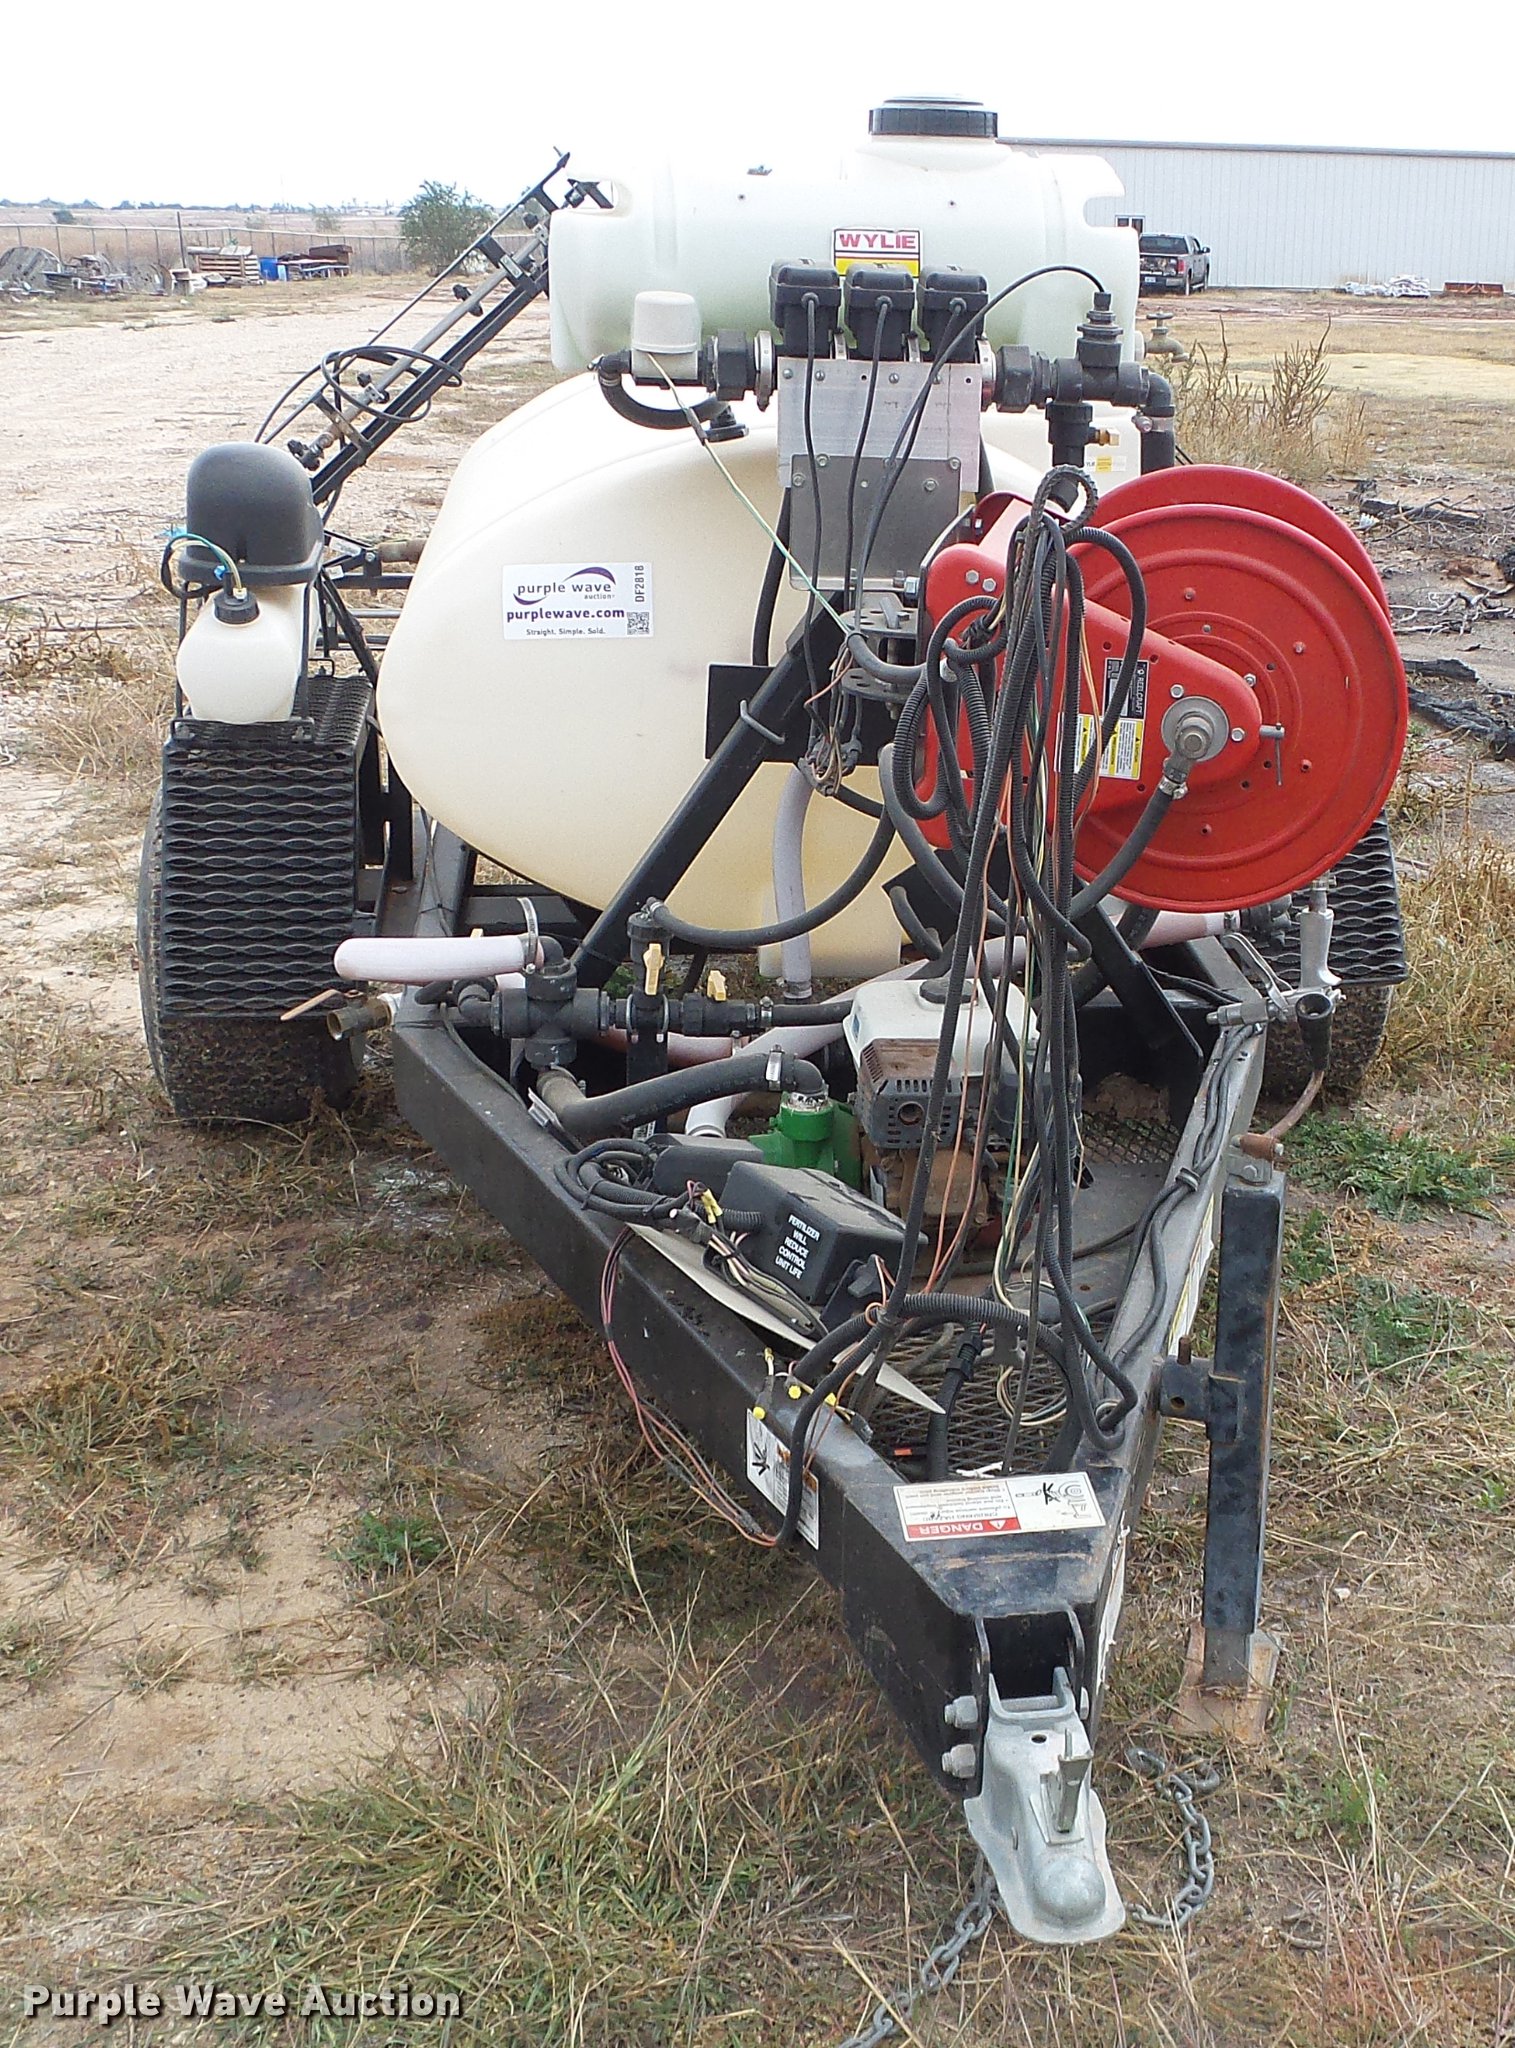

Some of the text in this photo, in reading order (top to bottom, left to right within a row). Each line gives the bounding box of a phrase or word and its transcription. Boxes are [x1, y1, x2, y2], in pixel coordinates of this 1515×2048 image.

[839, 234, 916, 249] WYLIE
[518, 582, 612, 596] purple wave
[634, 565, 645, 603] DF2818
[507, 607, 625, 623] purplewave.com
[526, 627, 606, 637] Straight. Simple. Sold.
[788, 1214, 821, 1241] FERTILIZER
[793, 1229, 807, 1246] WILL
[784, 1236, 809, 1259] REDUCE
[778, 1246, 806, 1270] CONTROL
[775, 1255, 803, 1280] UNIT LIFE
[919, 1521, 984, 1535] DANGER
